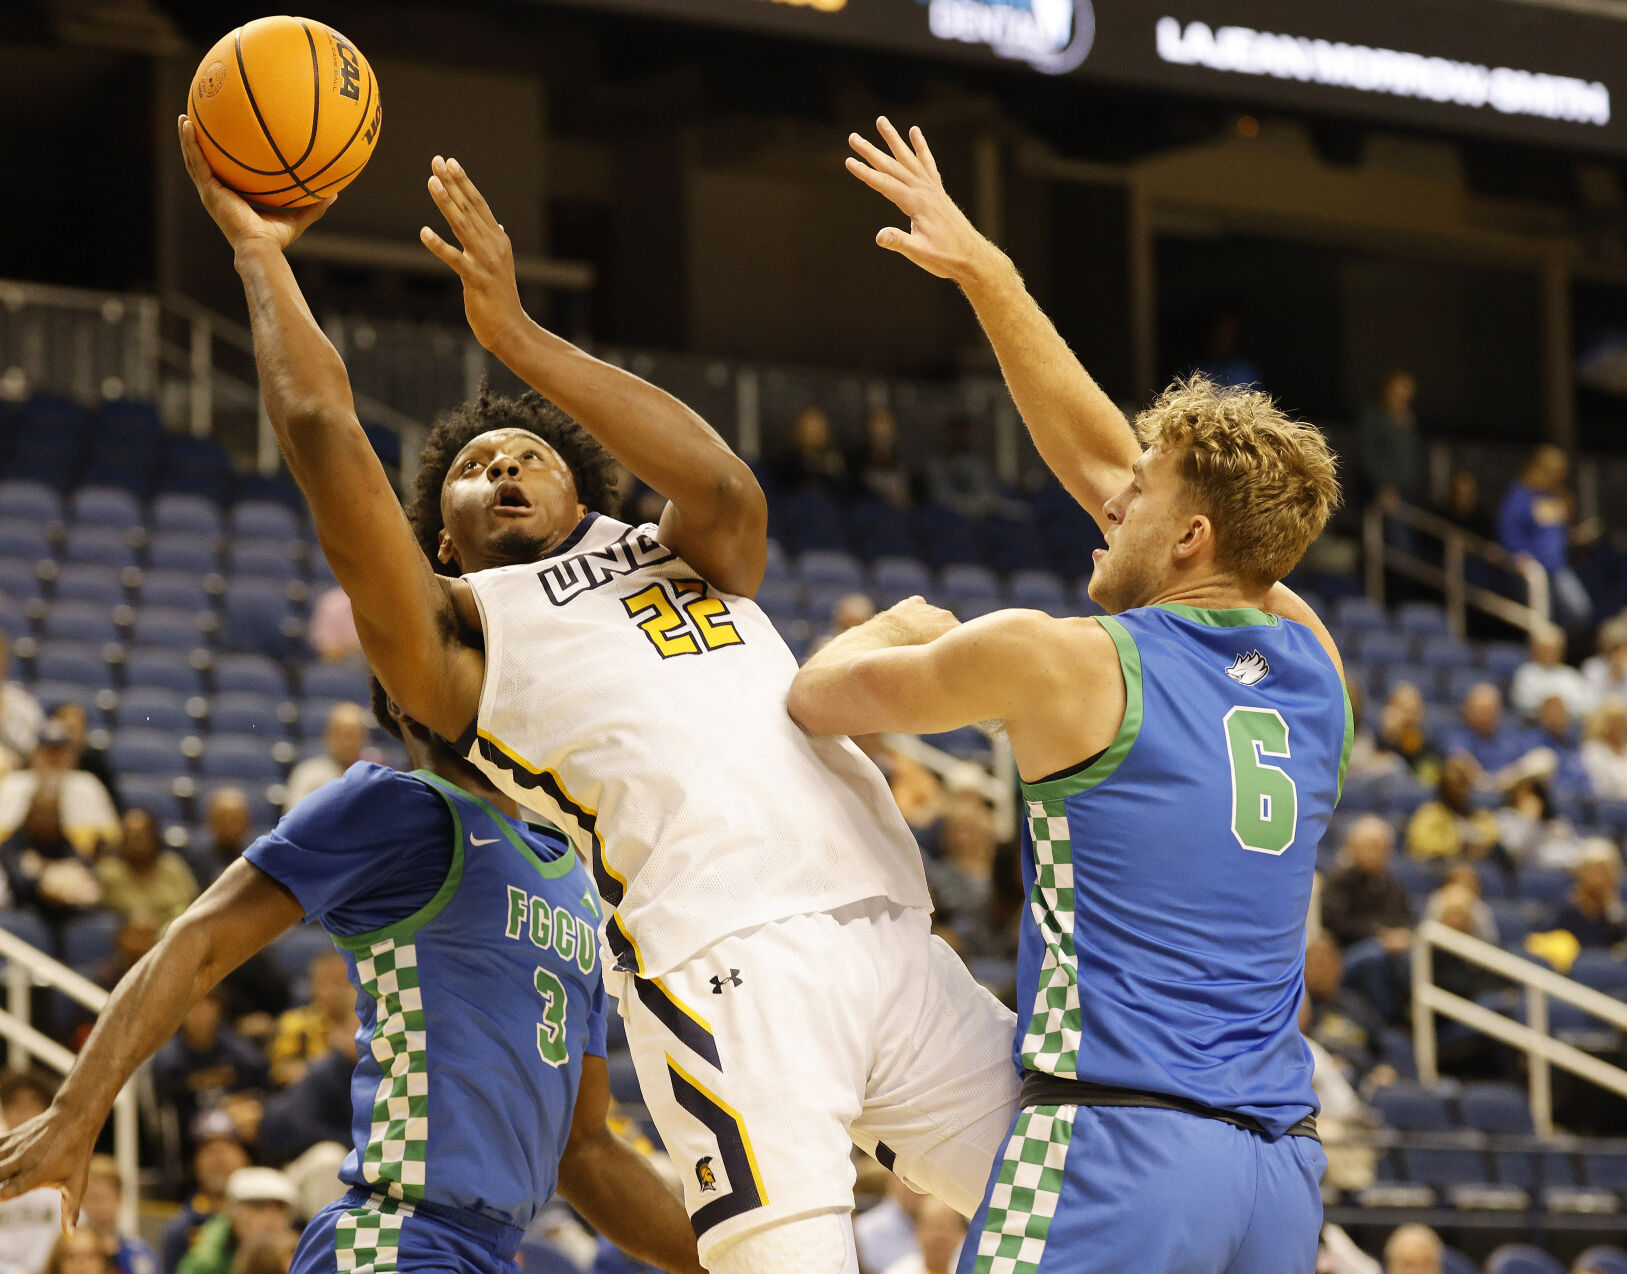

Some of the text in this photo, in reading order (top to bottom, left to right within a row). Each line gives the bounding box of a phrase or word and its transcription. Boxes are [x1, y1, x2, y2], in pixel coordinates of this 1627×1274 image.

[537, 526, 678, 607] UNC
[619, 577, 746, 660] 22
[1222, 705, 1298, 856] 6
[504, 884, 597, 976] FGCU
[533, 965, 570, 1069] 3
